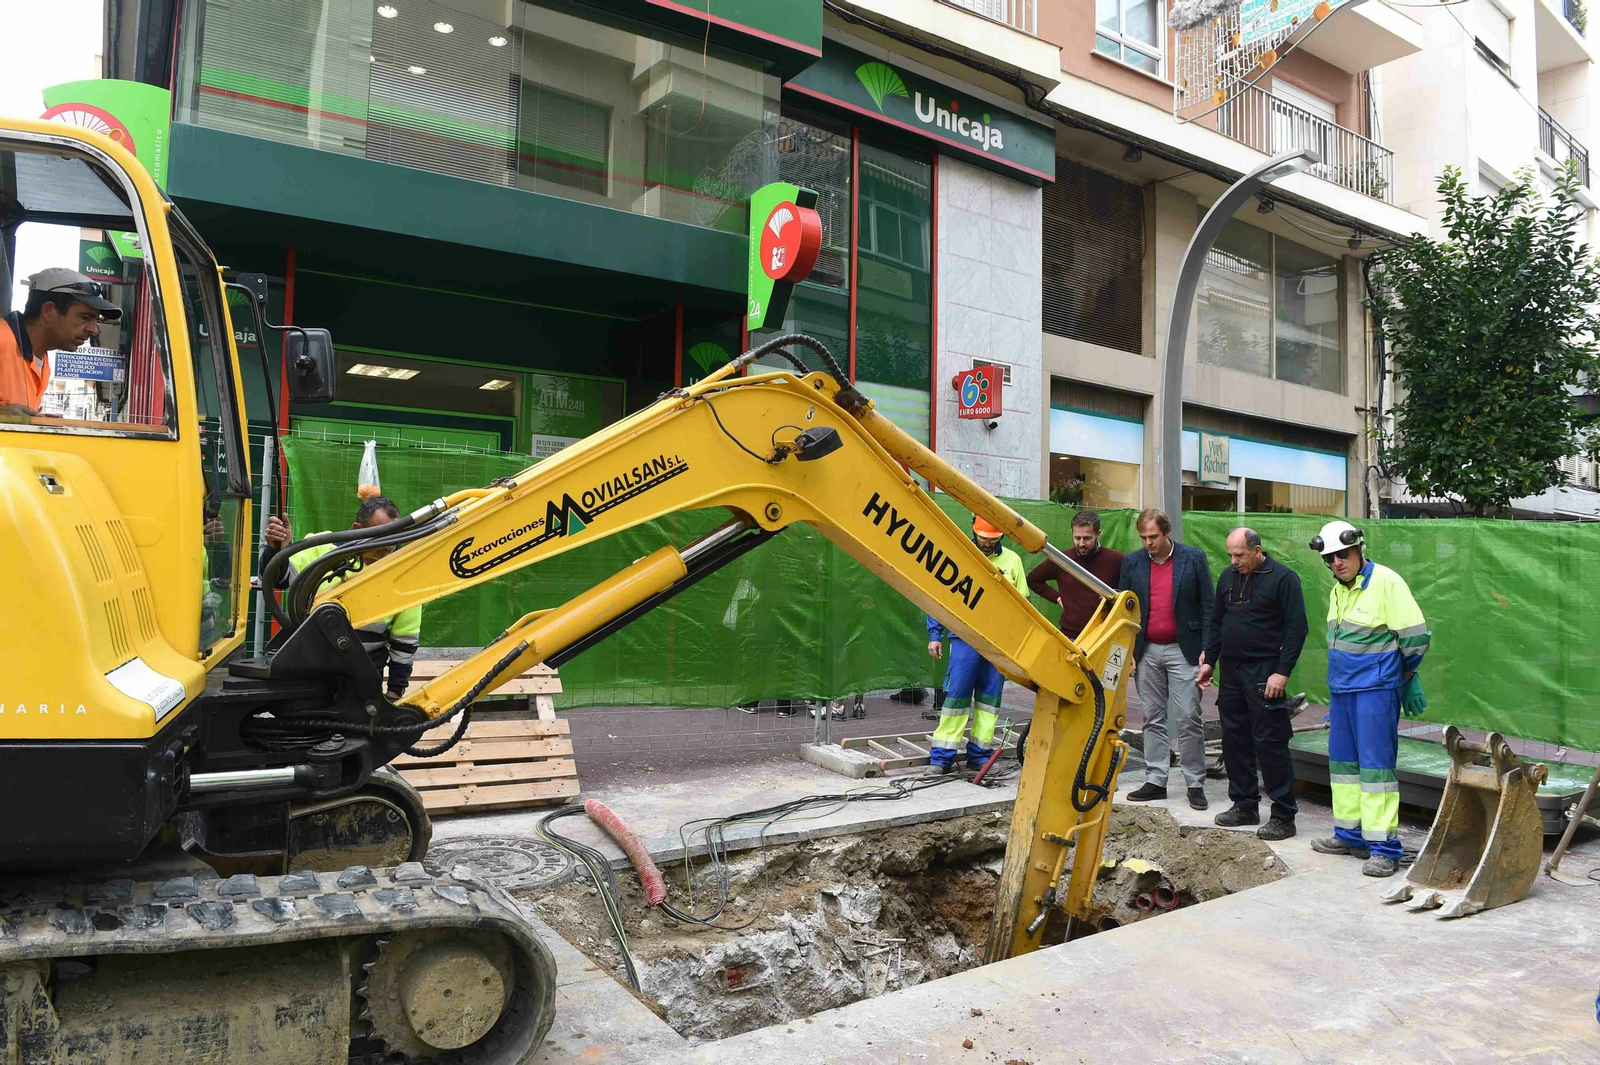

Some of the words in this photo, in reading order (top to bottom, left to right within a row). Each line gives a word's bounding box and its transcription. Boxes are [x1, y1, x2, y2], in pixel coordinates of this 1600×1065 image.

[915, 91, 1003, 151] Unicaja
[86, 265, 115, 276] Unicaja
[749, 300, 761, 320] 24
[57, 353, 94, 362] FOTOCOPIAS
[538, 388, 569, 409] ATM
[568, 399, 585, 411] 24H
[959, 408, 975, 416] EURO
[975, 407, 991, 415] 6000
[1208, 440, 1223, 459] Yves
[1203, 455, 1227, 474] Rocher
[449, 516, 545, 578] Excavaciones
[667, 454, 685, 469] S.L.
[862, 492, 985, 610] HYUNDAI
